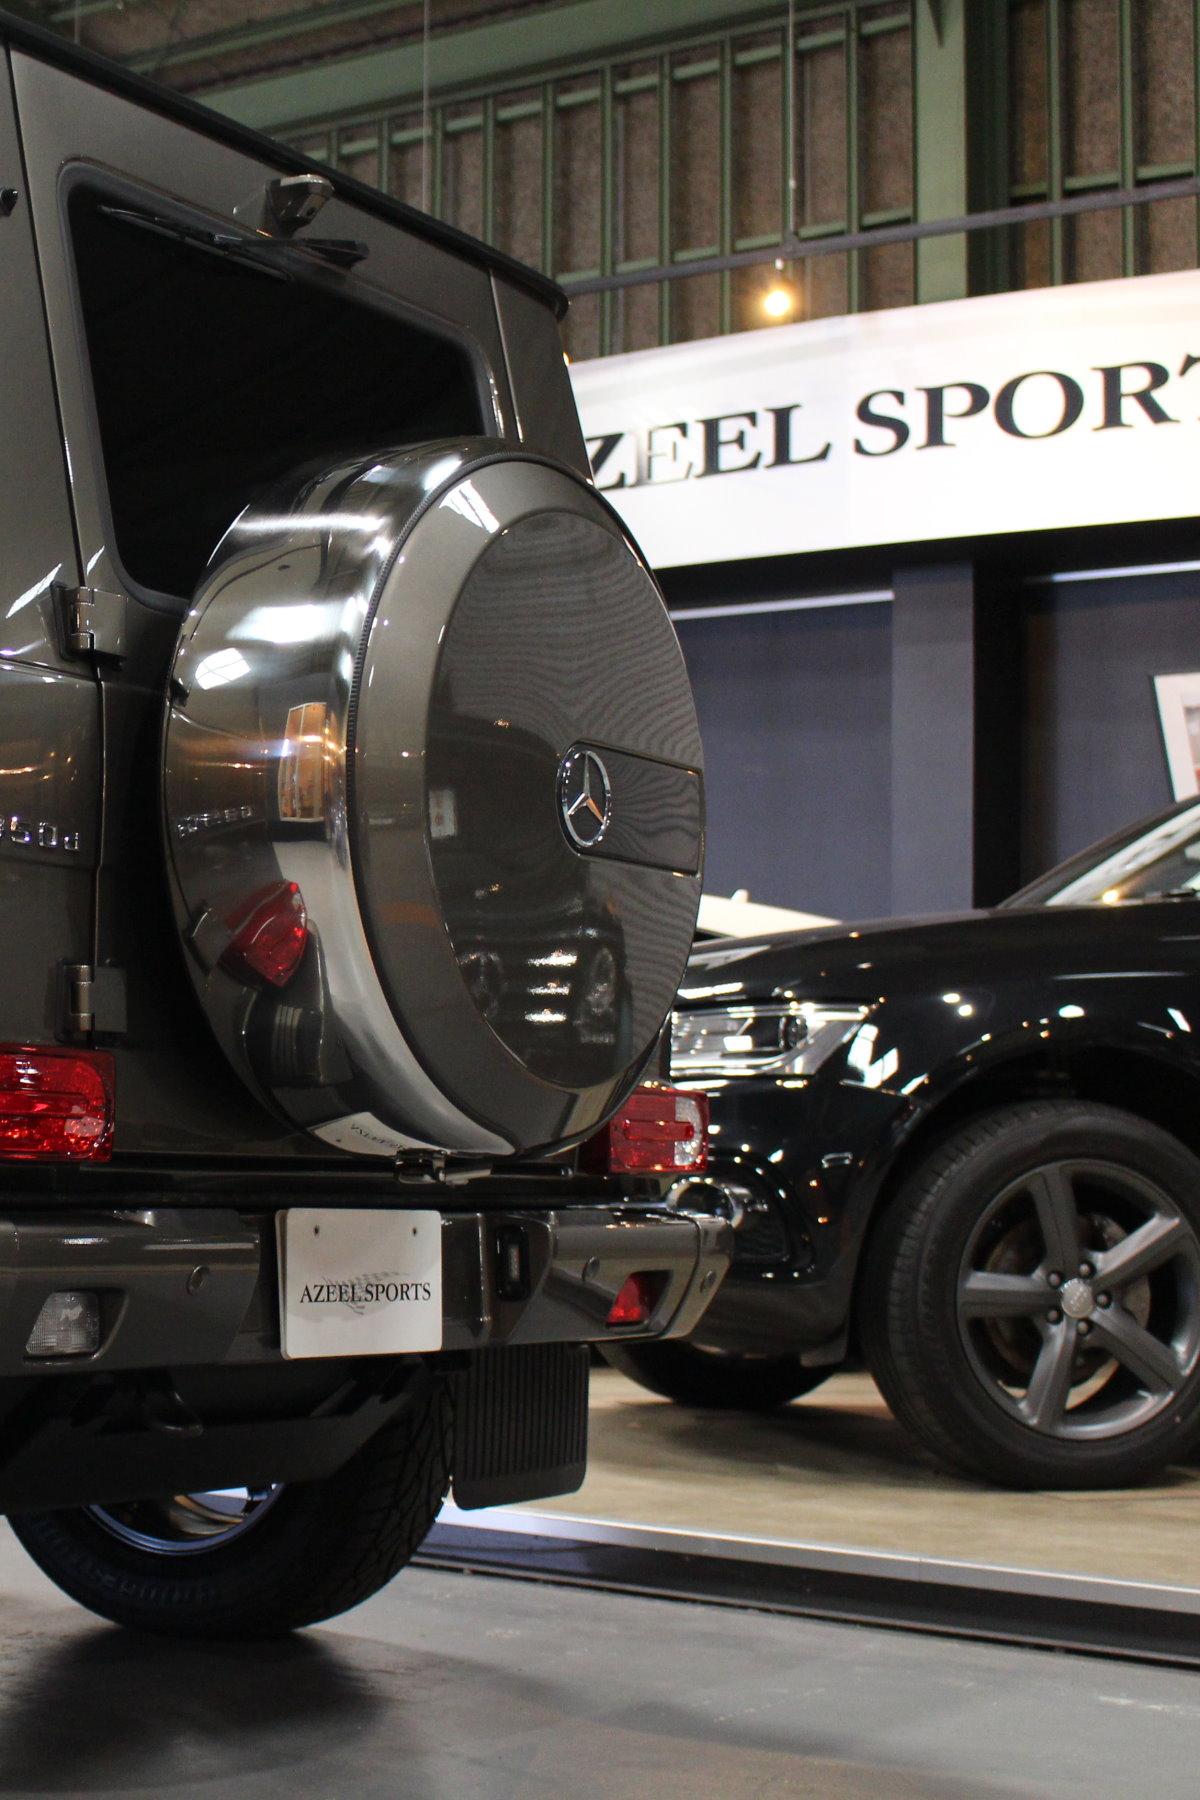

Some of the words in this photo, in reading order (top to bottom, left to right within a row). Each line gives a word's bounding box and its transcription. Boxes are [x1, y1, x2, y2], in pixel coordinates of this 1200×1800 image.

[585, 404, 832, 490] ZEEL
[853, 353, 1200, 457] SPOR
[299, 1284, 362, 1304] AZEEL
[364, 1282, 432, 1302] SPORTS
